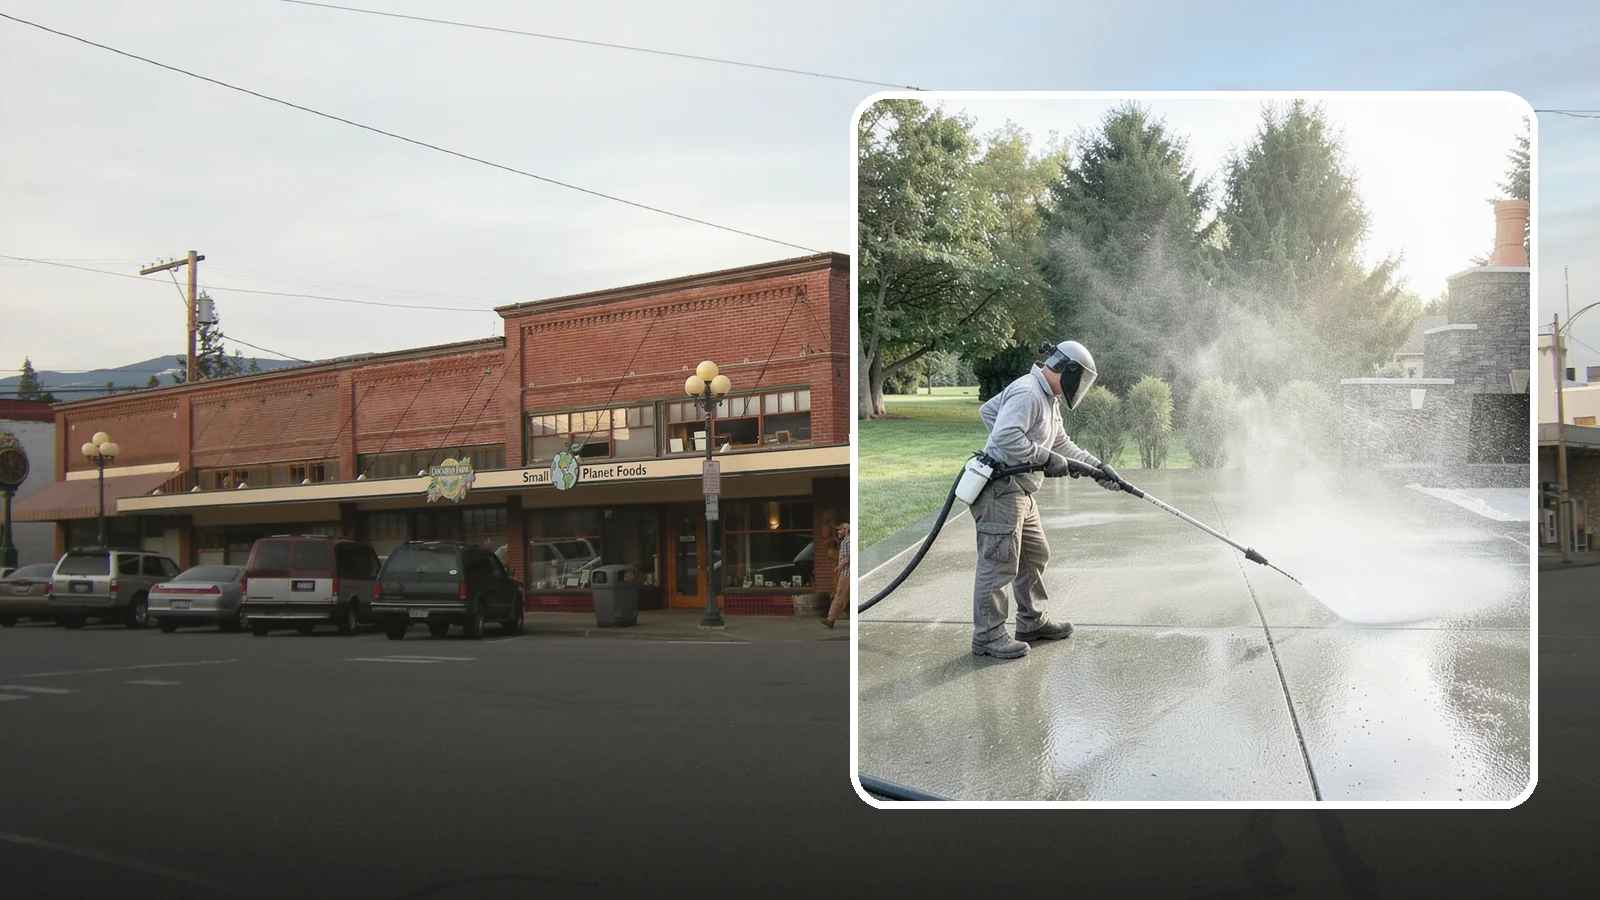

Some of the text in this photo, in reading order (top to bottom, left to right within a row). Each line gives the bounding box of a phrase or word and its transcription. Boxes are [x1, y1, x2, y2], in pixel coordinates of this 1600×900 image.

[523, 465, 647, 482] Small Planet Foods
